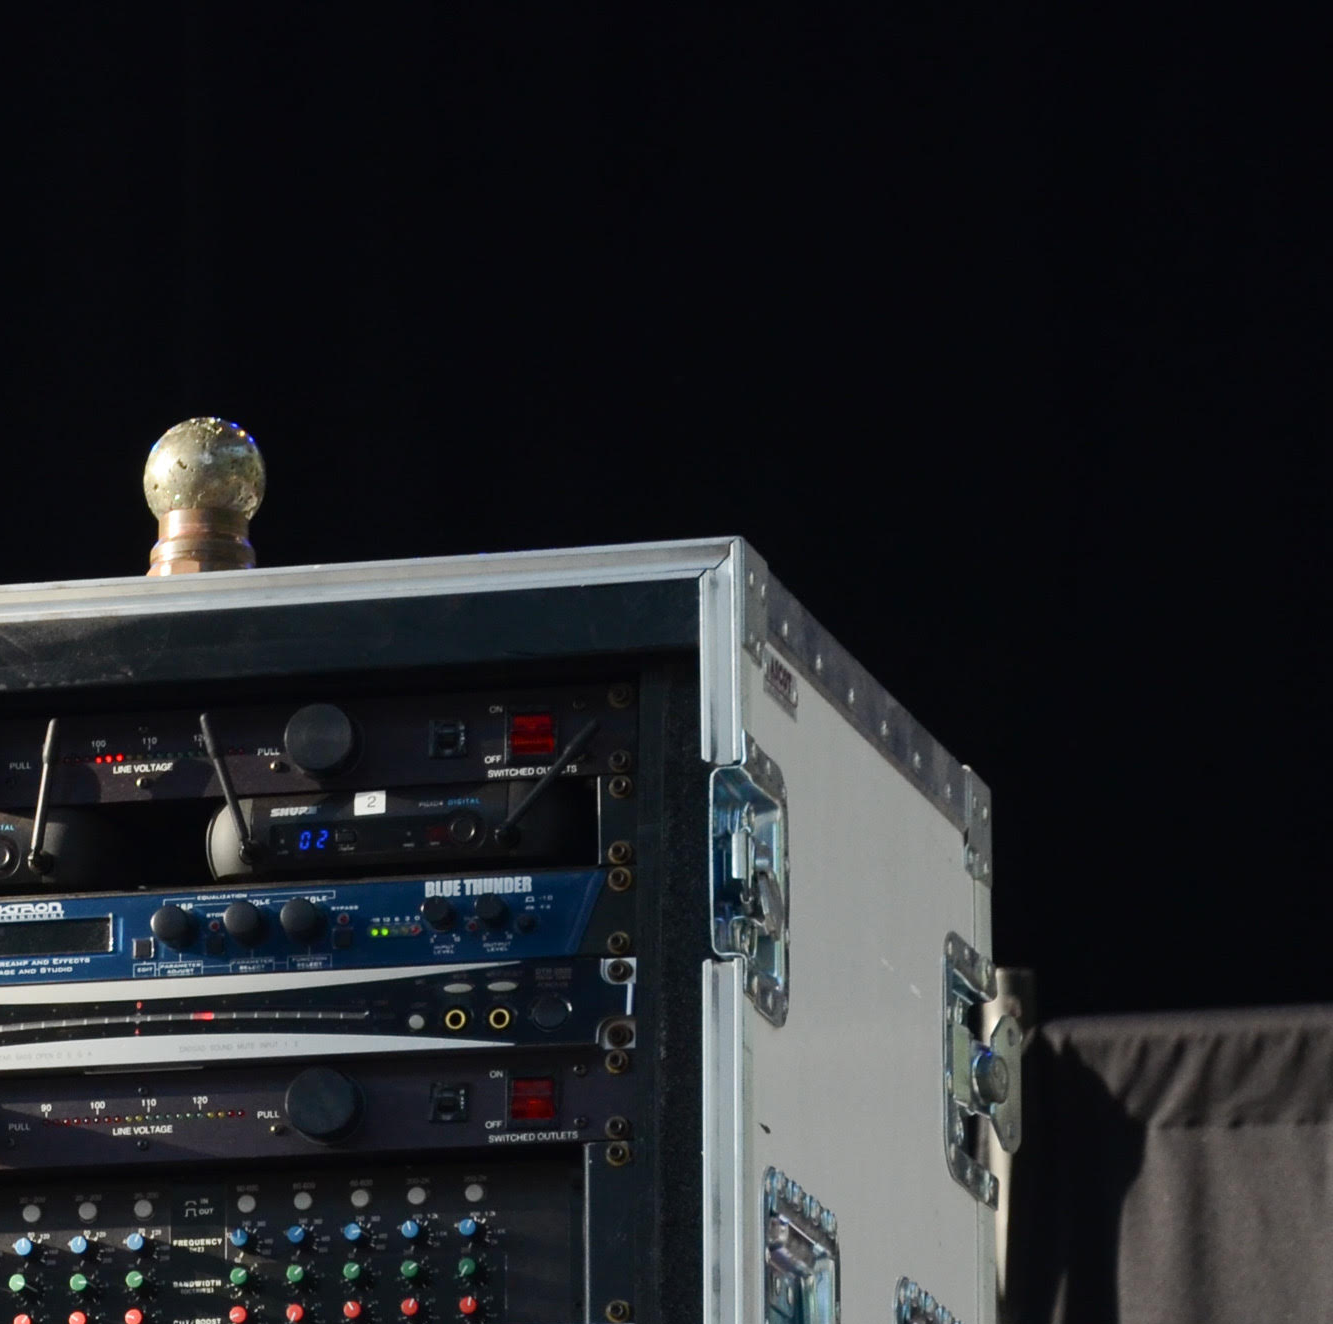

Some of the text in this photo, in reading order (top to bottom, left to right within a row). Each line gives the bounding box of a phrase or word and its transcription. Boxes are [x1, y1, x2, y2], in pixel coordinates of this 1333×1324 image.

[489, 705, 503, 713] ON
[91, 737, 158, 748] 100 110
[257, 748, 281, 757] PULL
[484, 755, 502, 764] OFF
[9, 762, 32, 771] PULL
[113, 762, 173, 775] LINE VOLTAGE
[488, 767, 534, 778] SWITCHED
[367, 796, 376, 808] 2
[447, 798, 480, 806] DIGITAL
[299, 829, 329, 851] 02
[425, 876, 533, 897] BLUE THUNDER
[489, 1070, 503, 1078] ON
[41, 1096, 208, 1113] 90 100 110 120
[257, 1110, 280, 1119] PULL
[8, 1123, 31, 1131] PULL
[485, 1120, 503, 1129] OFF
[112, 1124, 173, 1137] LINE VOLTAGE
[488, 1130, 578, 1144] SWITCHED OUTLETS
[173, 1238, 223, 1247] FREQUENCY
[173, 1280, 222, 1288] BANDWIDTH
